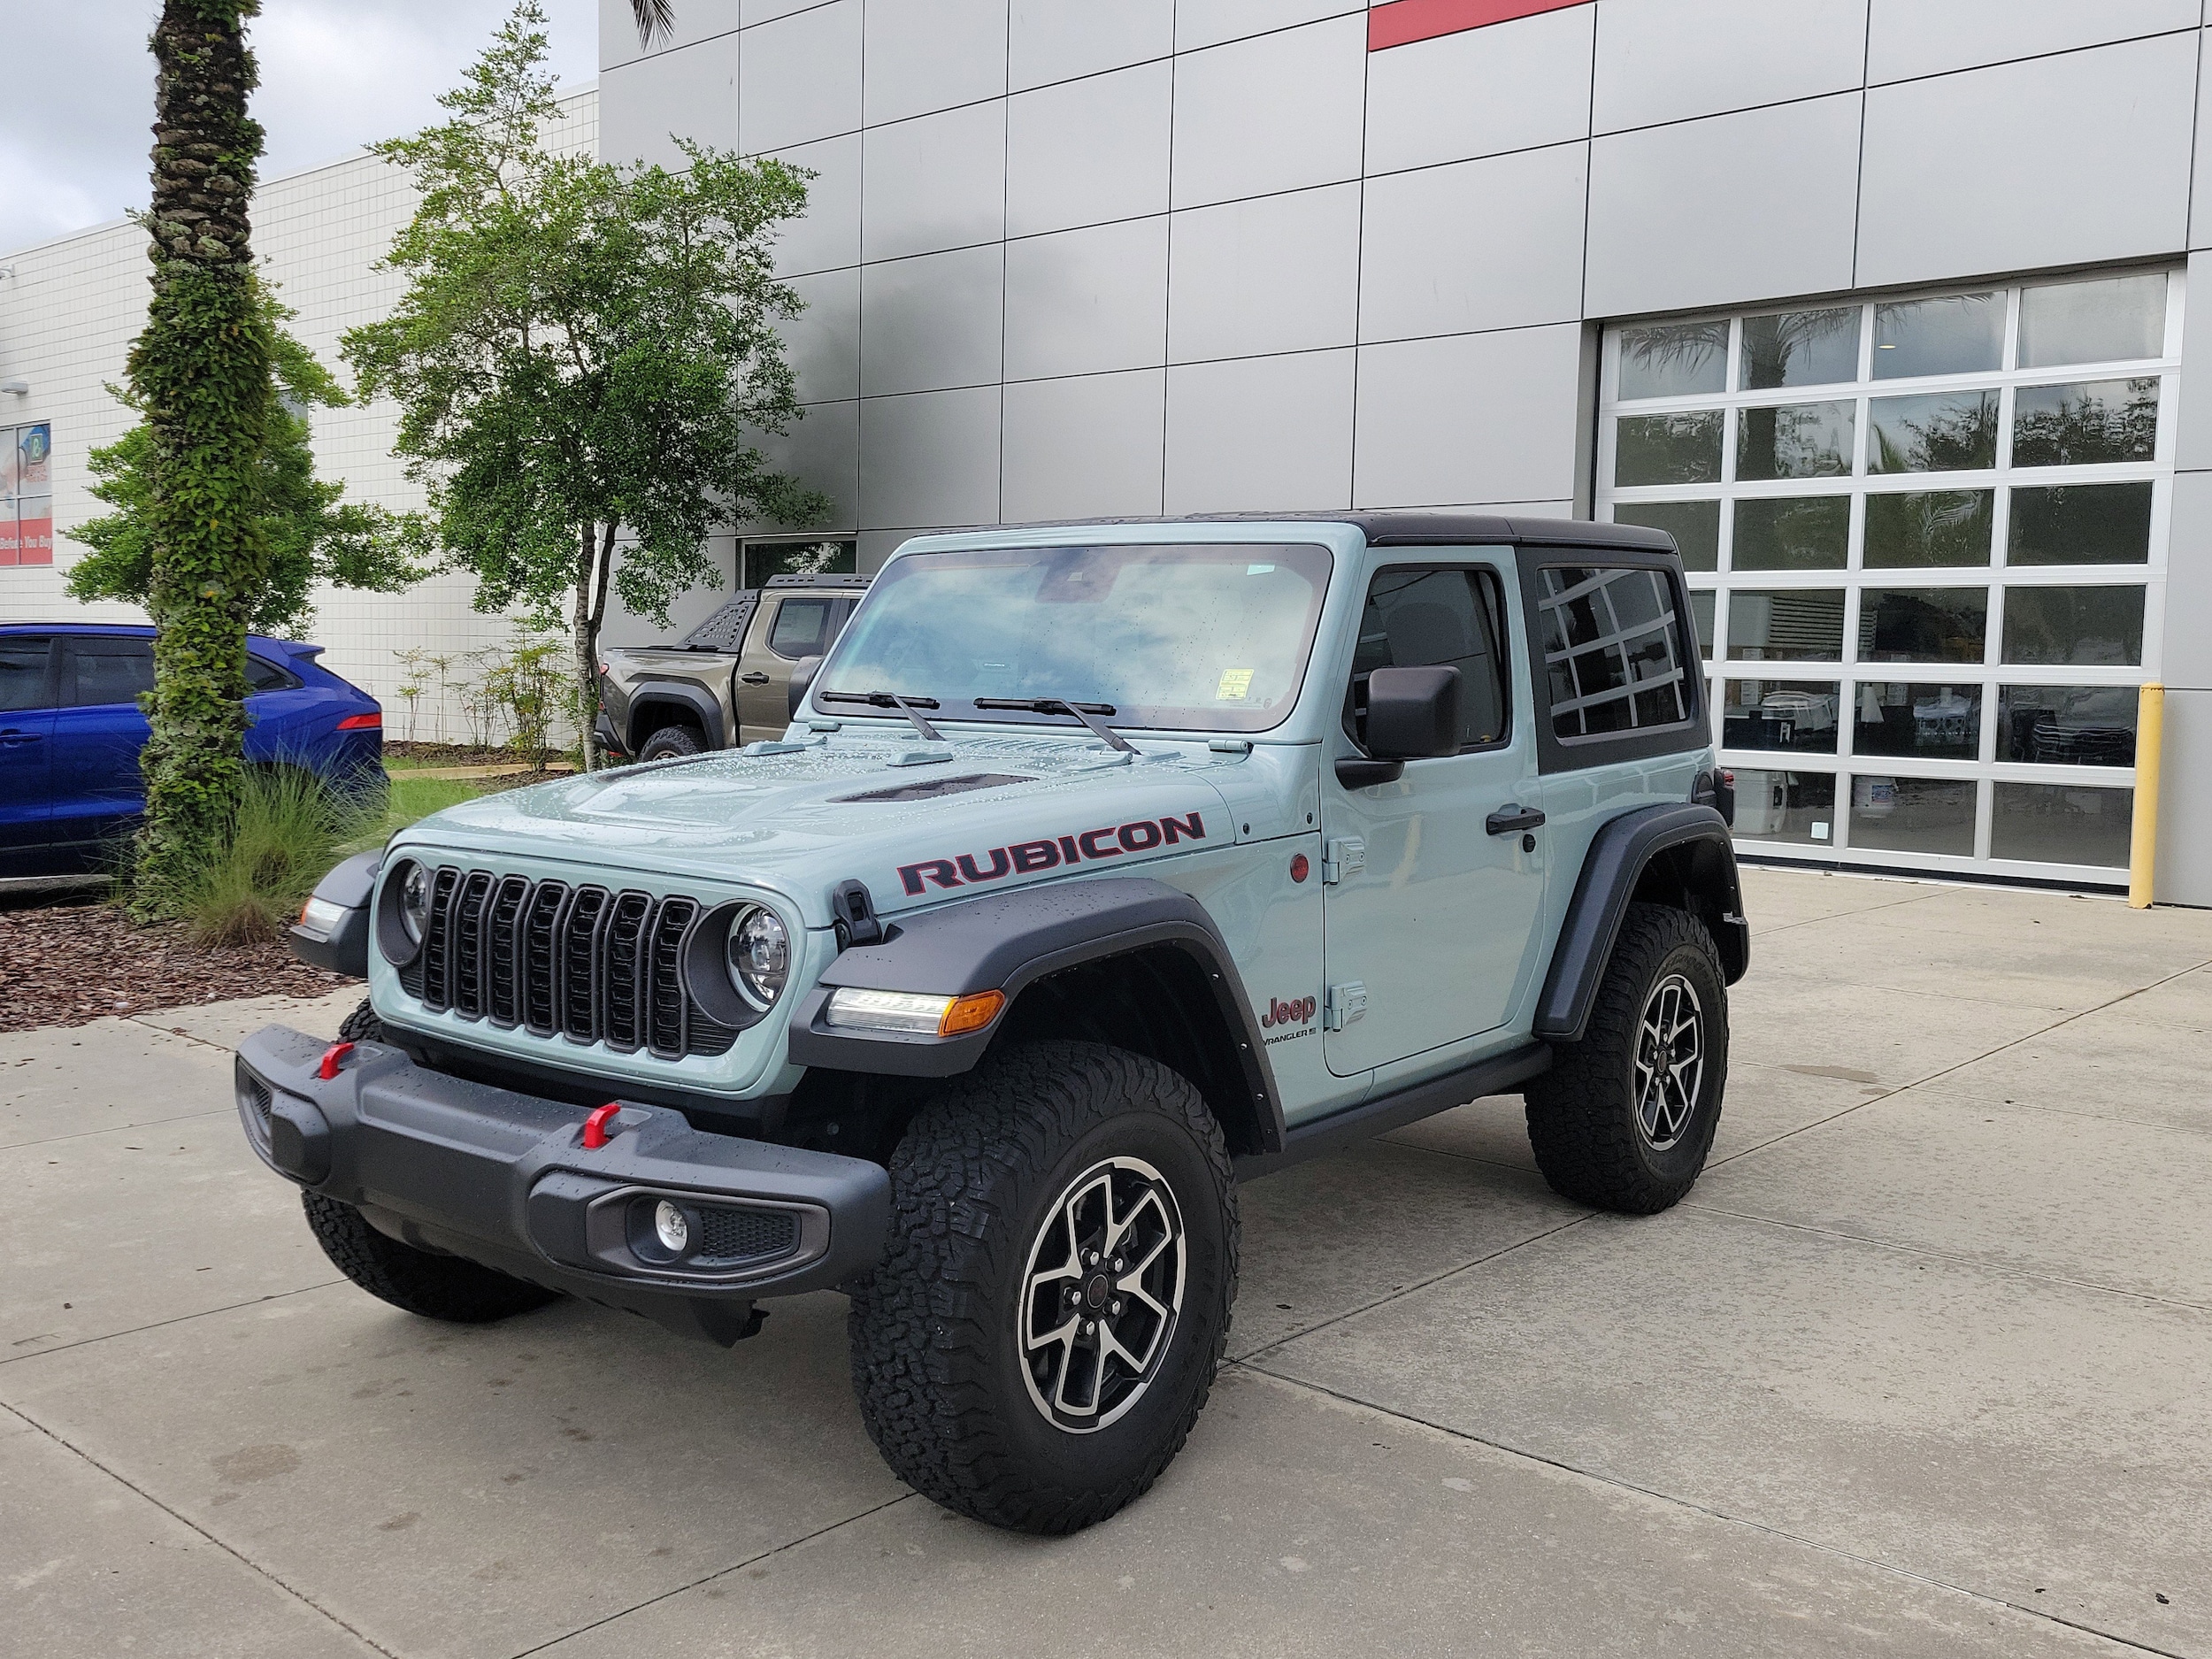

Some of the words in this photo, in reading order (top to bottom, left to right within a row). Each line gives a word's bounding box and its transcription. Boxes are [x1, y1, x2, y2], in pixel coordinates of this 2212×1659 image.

[24, 535, 37, 549] You
[39, 535, 52, 549] Buy
[896, 811, 1206, 896] RUBICON
[1262, 995, 1317, 1028] Jeep
